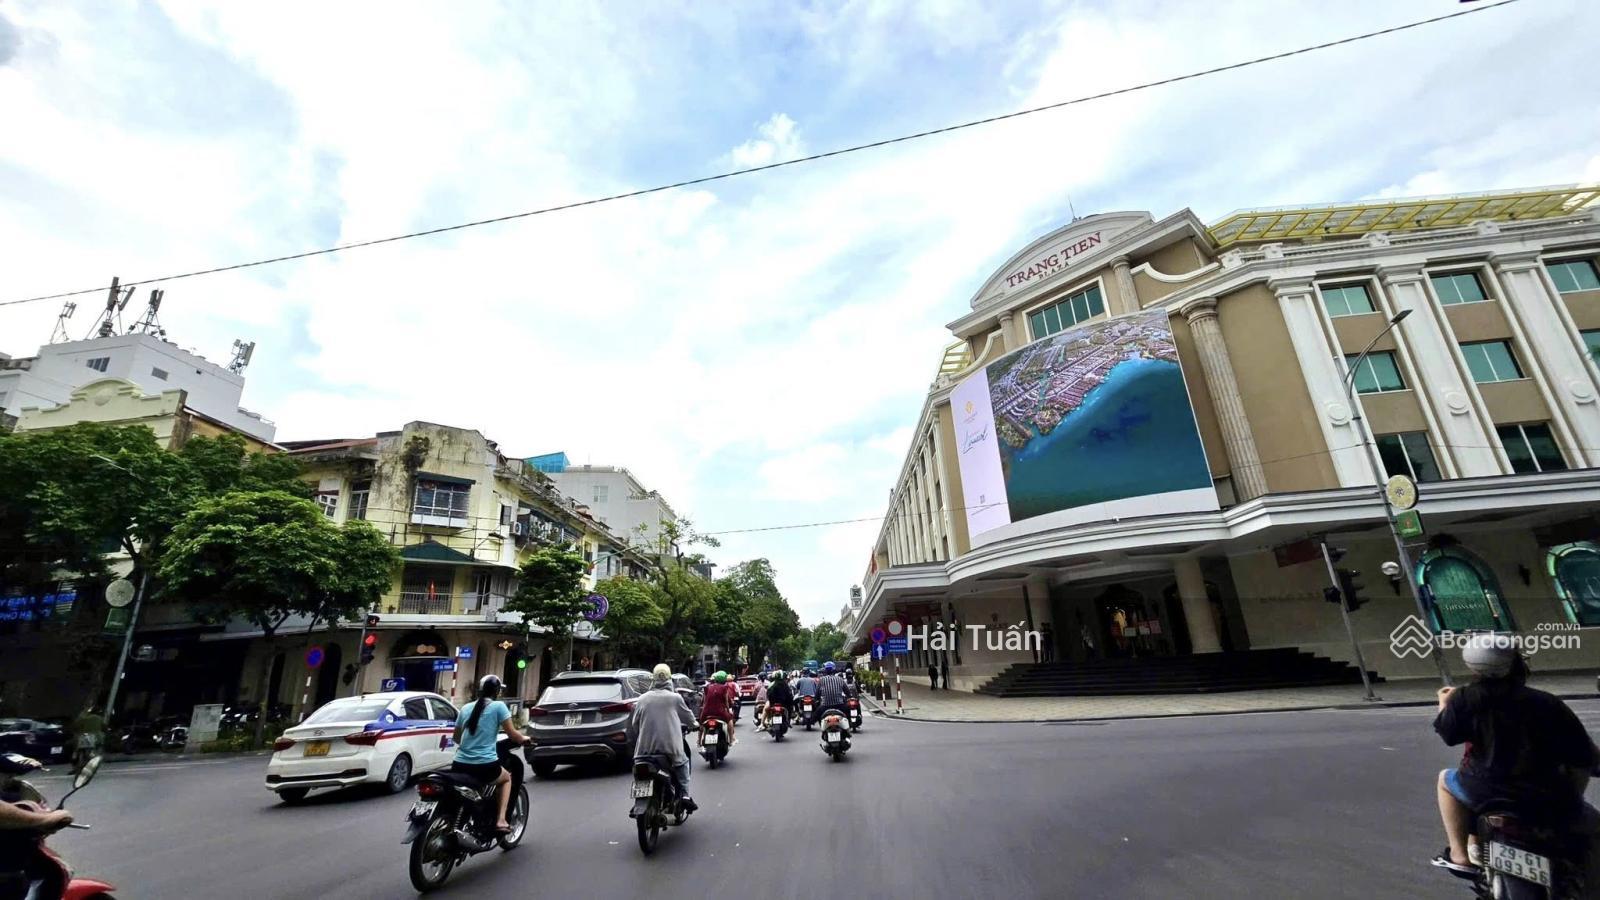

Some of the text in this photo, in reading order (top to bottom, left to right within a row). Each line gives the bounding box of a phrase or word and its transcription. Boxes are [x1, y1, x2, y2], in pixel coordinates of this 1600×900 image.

[1006, 232, 1102, 288] TRANG TIEN
[1039, 261, 1070, 279] PLAZA
